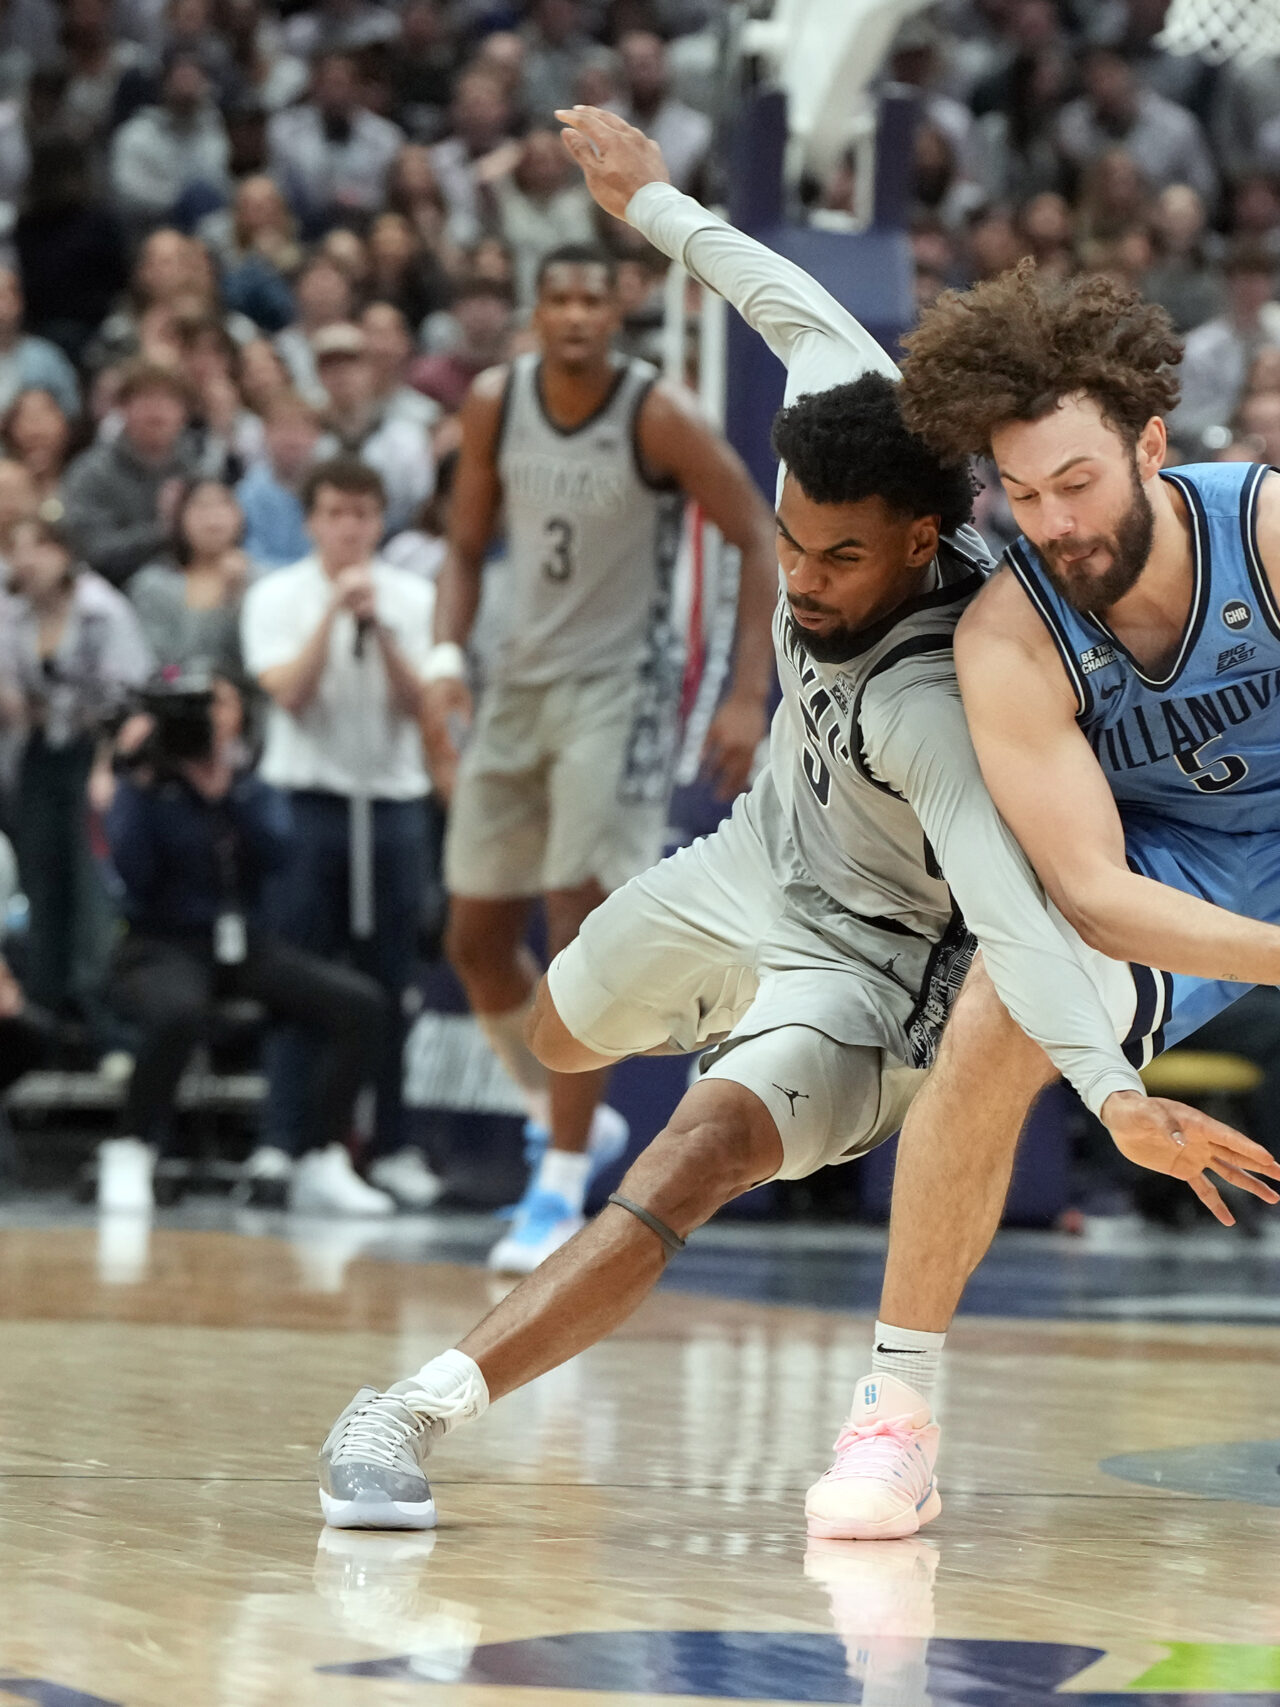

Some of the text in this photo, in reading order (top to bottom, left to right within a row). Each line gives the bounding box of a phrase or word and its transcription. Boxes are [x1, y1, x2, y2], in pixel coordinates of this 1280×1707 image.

[545, 518, 572, 582] 3
[1224, 606, 1249, 625] GHR
[1080, 649, 1096, 664] BE
[1216, 647, 1257, 671] EAST
[1217, 642, 1248, 661] BIG
[1173, 733, 1249, 794] 5
